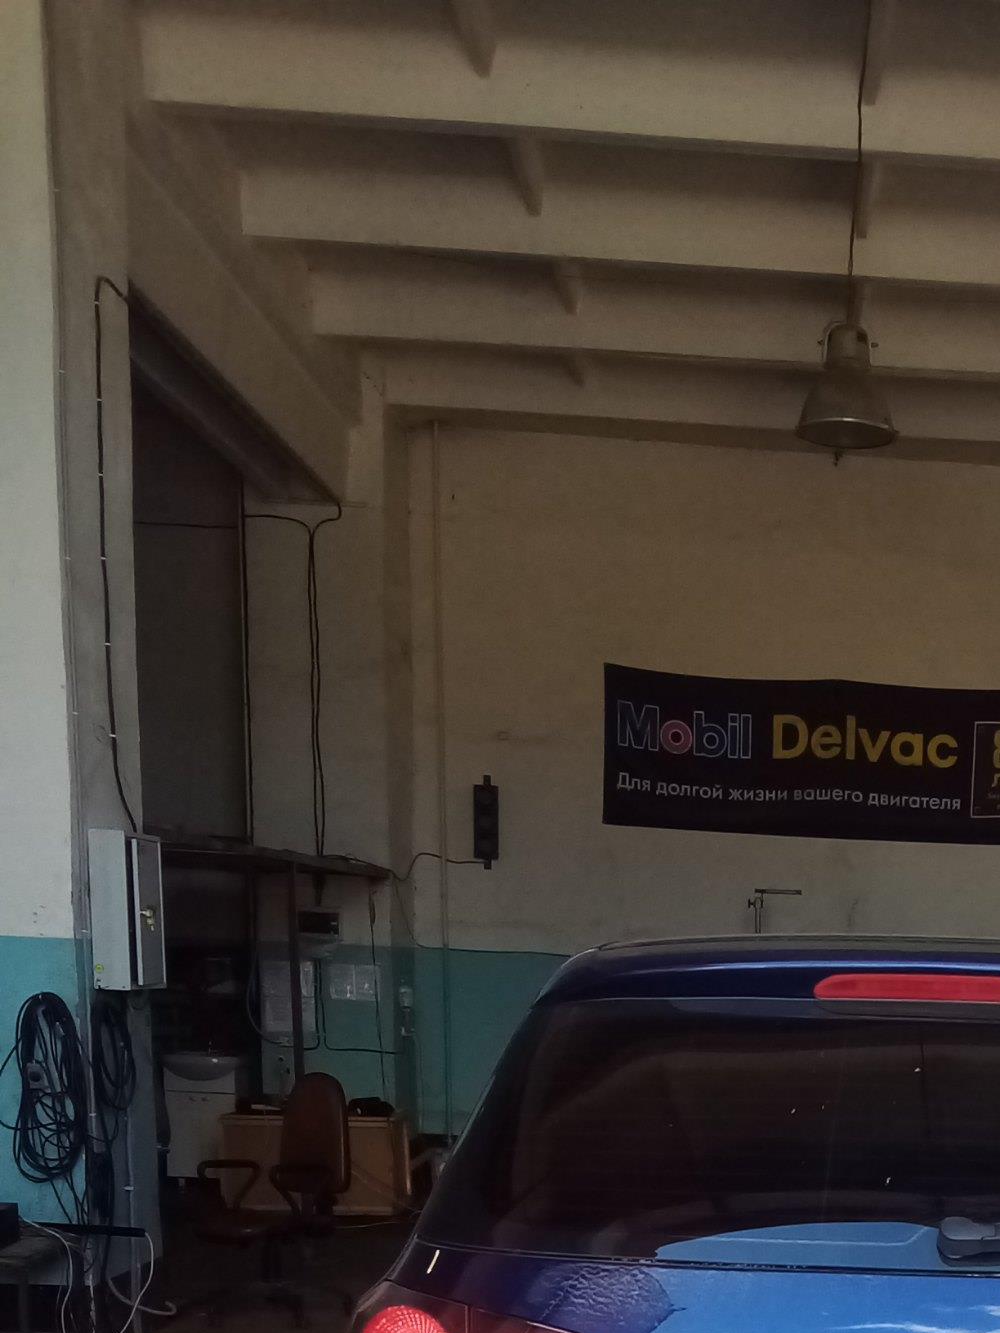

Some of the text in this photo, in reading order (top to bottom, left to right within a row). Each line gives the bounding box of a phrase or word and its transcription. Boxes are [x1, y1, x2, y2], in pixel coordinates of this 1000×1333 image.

[617, 700, 958, 768] Mobil Delvac
[617, 772, 961, 811] Для долгой жизни вашего двигателя
